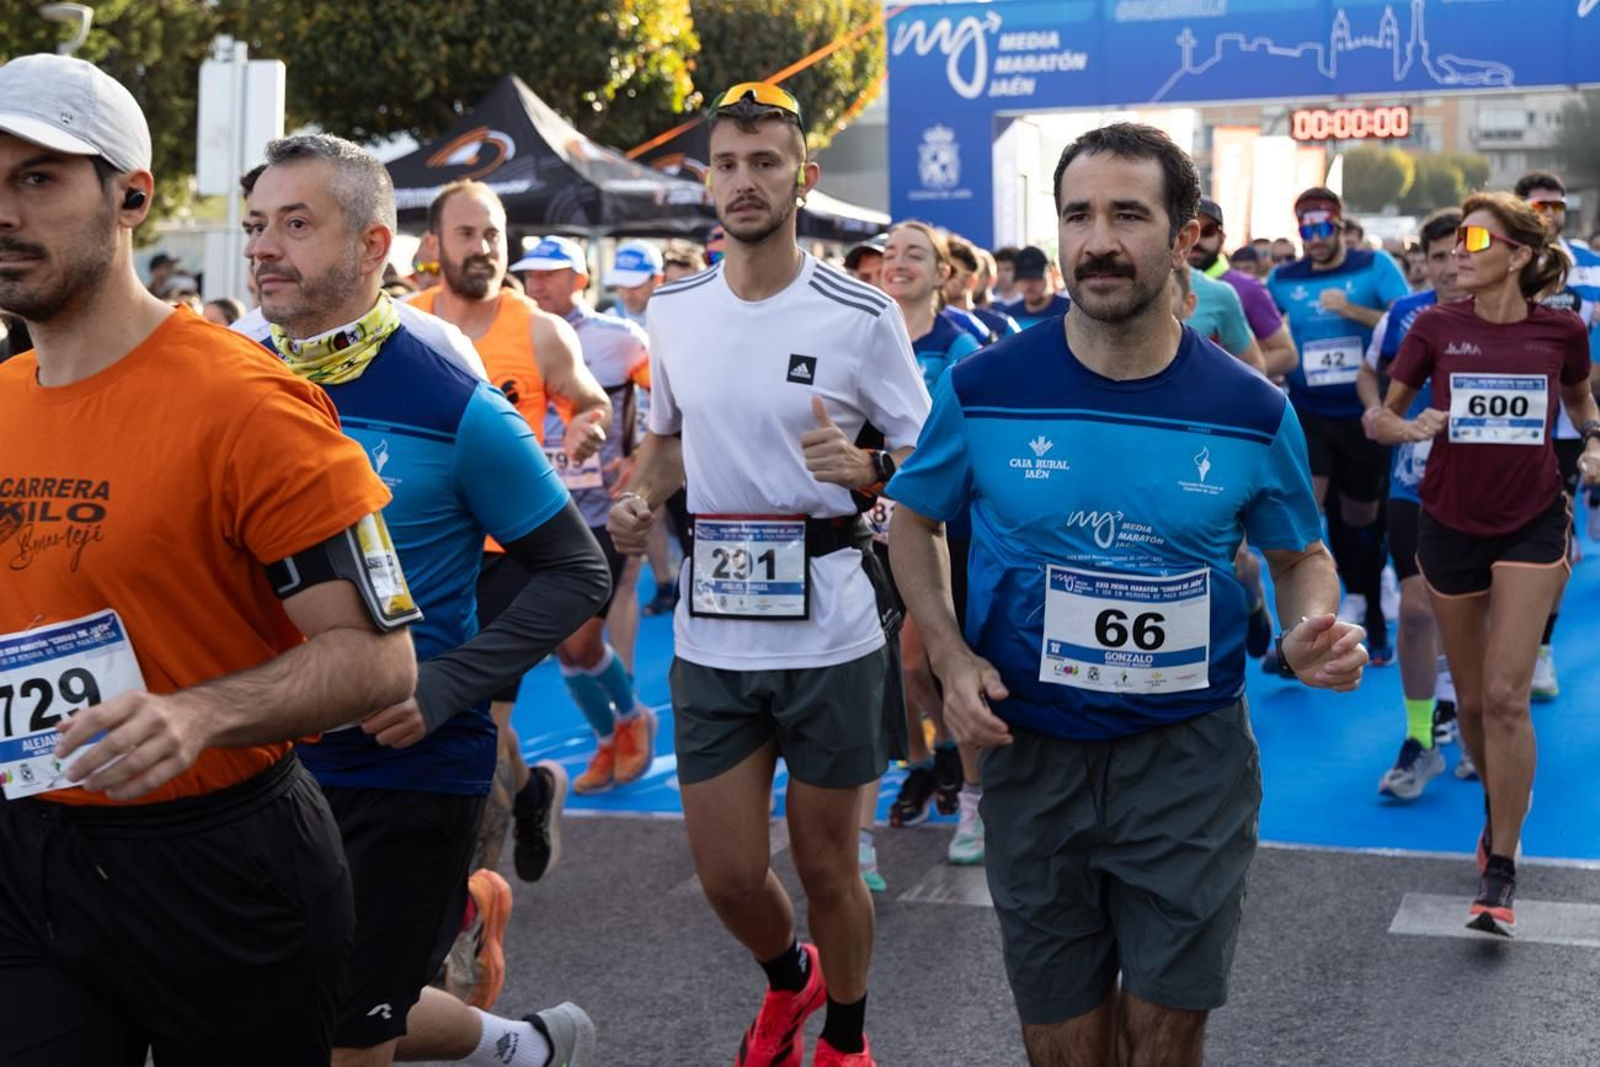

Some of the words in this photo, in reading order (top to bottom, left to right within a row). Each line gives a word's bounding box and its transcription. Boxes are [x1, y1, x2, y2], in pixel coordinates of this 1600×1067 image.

[999, 31, 1060, 51] MEDIA
[994, 50, 1088, 74] MARATÓN
[988, 75, 1036, 97] JAÉN
[1294, 106, 1409, 140] 00:00:00
[1321, 352, 1346, 367] 42
[1468, 395, 1529, 417] 600
[1035, 459, 1070, 470] RURAL
[0, 477, 110, 501] CARRERA
[1118, 531, 1165, 545] MARATÓN
[1121, 522, 1152, 534] MEDIA
[711, 547, 776, 581] 291
[1094, 608, 1166, 651] 66
[1104, 652, 1154, 664] GONZALO
[0, 667, 103, 738] 729
